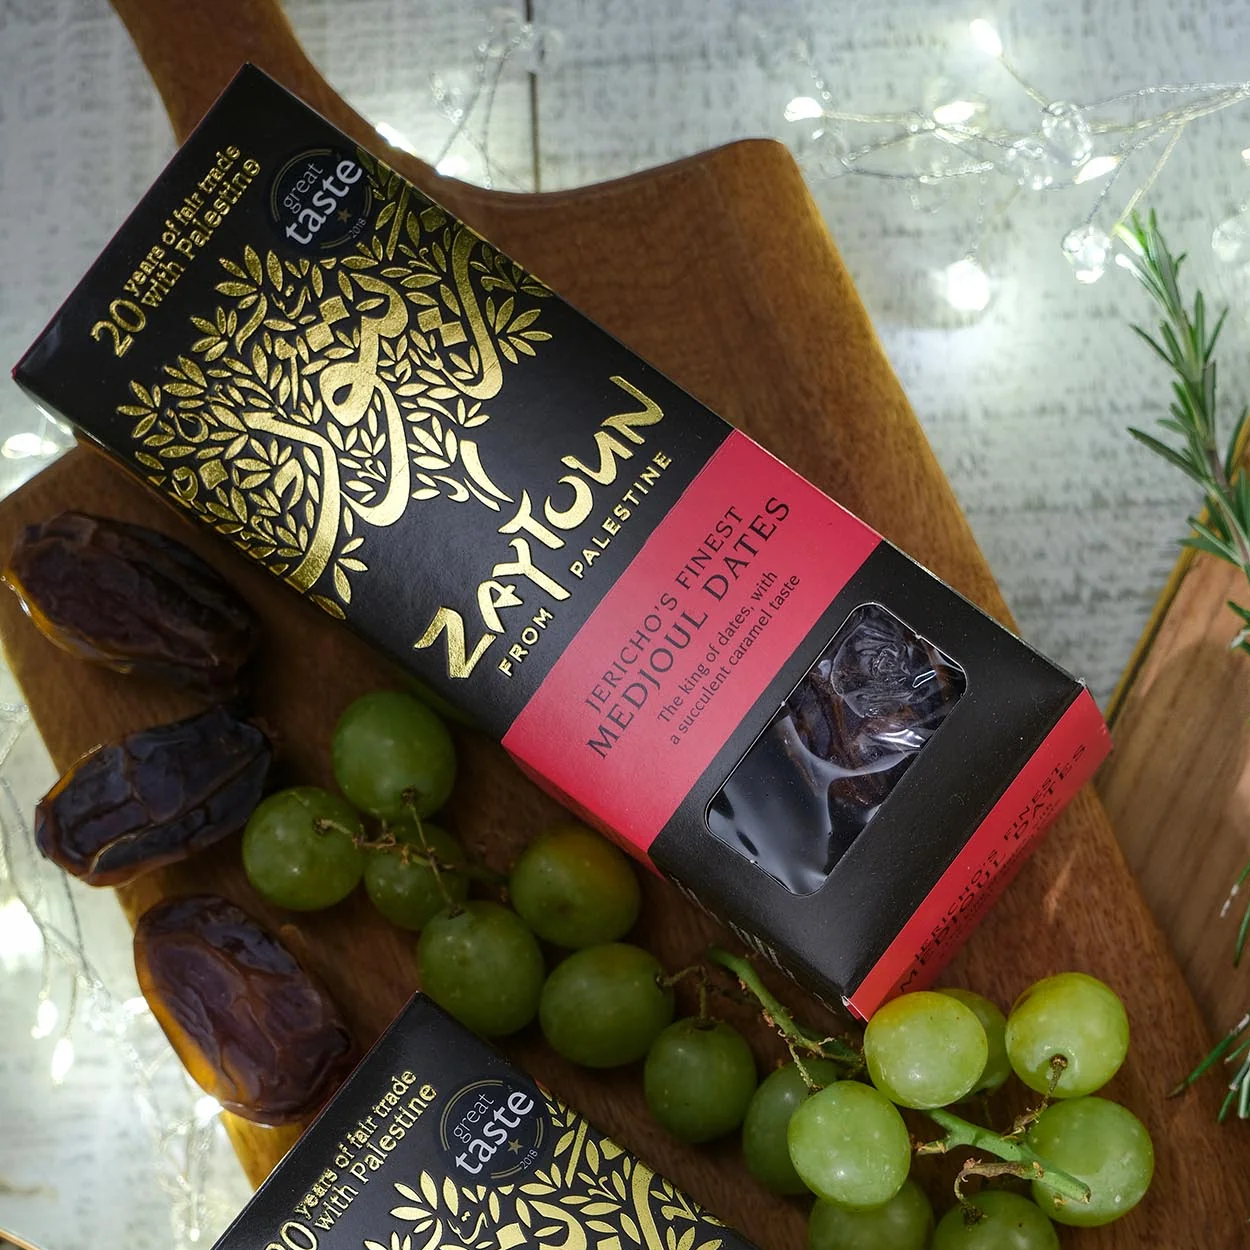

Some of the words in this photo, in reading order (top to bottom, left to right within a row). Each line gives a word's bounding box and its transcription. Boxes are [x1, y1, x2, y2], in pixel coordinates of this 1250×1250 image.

[90, 298, 146, 357] 20
[123, 245, 165, 297] years
[162, 219, 181, 245] of
[173, 191, 204, 225] fair
[197, 145, 240, 193] trade
[140, 260, 185, 307] with
[174, 158, 260, 260] Palestine
[283, 162, 323, 214] great
[285, 160, 363, 244] taste
[414, 375, 664, 678] ZAYTOUN
[498, 607, 553, 676] FROM
[570, 451, 672, 578] PALESTINE
[584, 591, 679, 714] JERICHO'S
[675, 505, 743, 589] FINEST
[585, 609, 710, 760] MEDJOUL
[702, 496, 790, 601] DATES
[656, 695, 684, 722] The
[678, 663, 710, 694] king
[705, 642, 720, 662] of
[717, 605, 755, 645] dates,
[750, 571, 778, 600] with
[669, 733, 680, 744] a
[678, 665, 731, 733] succulent
[728, 608, 773, 665] caramel
[768, 575, 800, 610] taste
[294, 1167, 338, 1219] years
[335, 1143, 355, 1168] of
[346, 1115, 378, 1148] fair
[372, 1070, 416, 1117] trade
[314, 1185, 359, 1230] with
[349, 1084, 437, 1184] Palestine
[453, 1093, 494, 1143] great
[455, 1091, 534, 1174] taste
[519, 1149, 538, 1170] 2018
